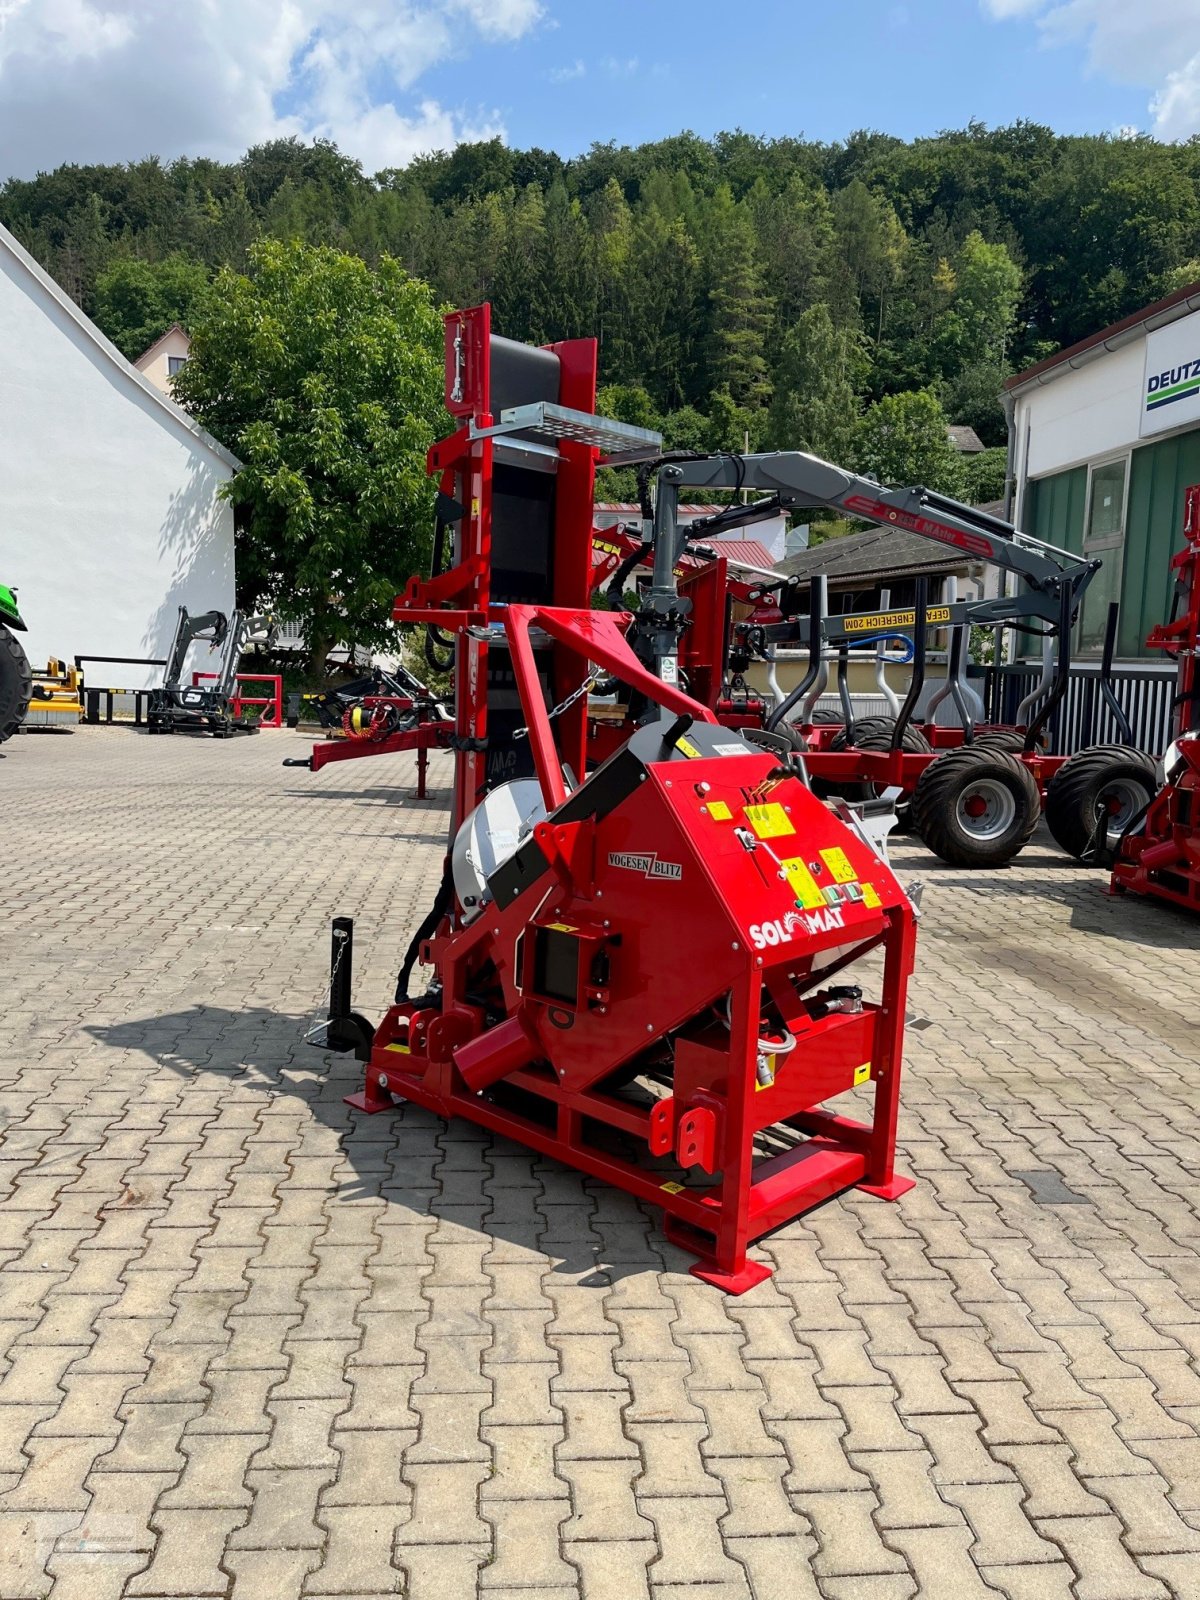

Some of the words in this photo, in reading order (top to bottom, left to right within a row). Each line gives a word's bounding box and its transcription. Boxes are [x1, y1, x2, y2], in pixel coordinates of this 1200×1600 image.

[1147, 358, 1200, 393] DEUTZ
[845, 618, 864, 630] 20M
[866, 609, 949, 627] GEFAENBEREICH
[609, 853, 649, 870] VOGESEN
[654, 862, 681, 877] BLITZ
